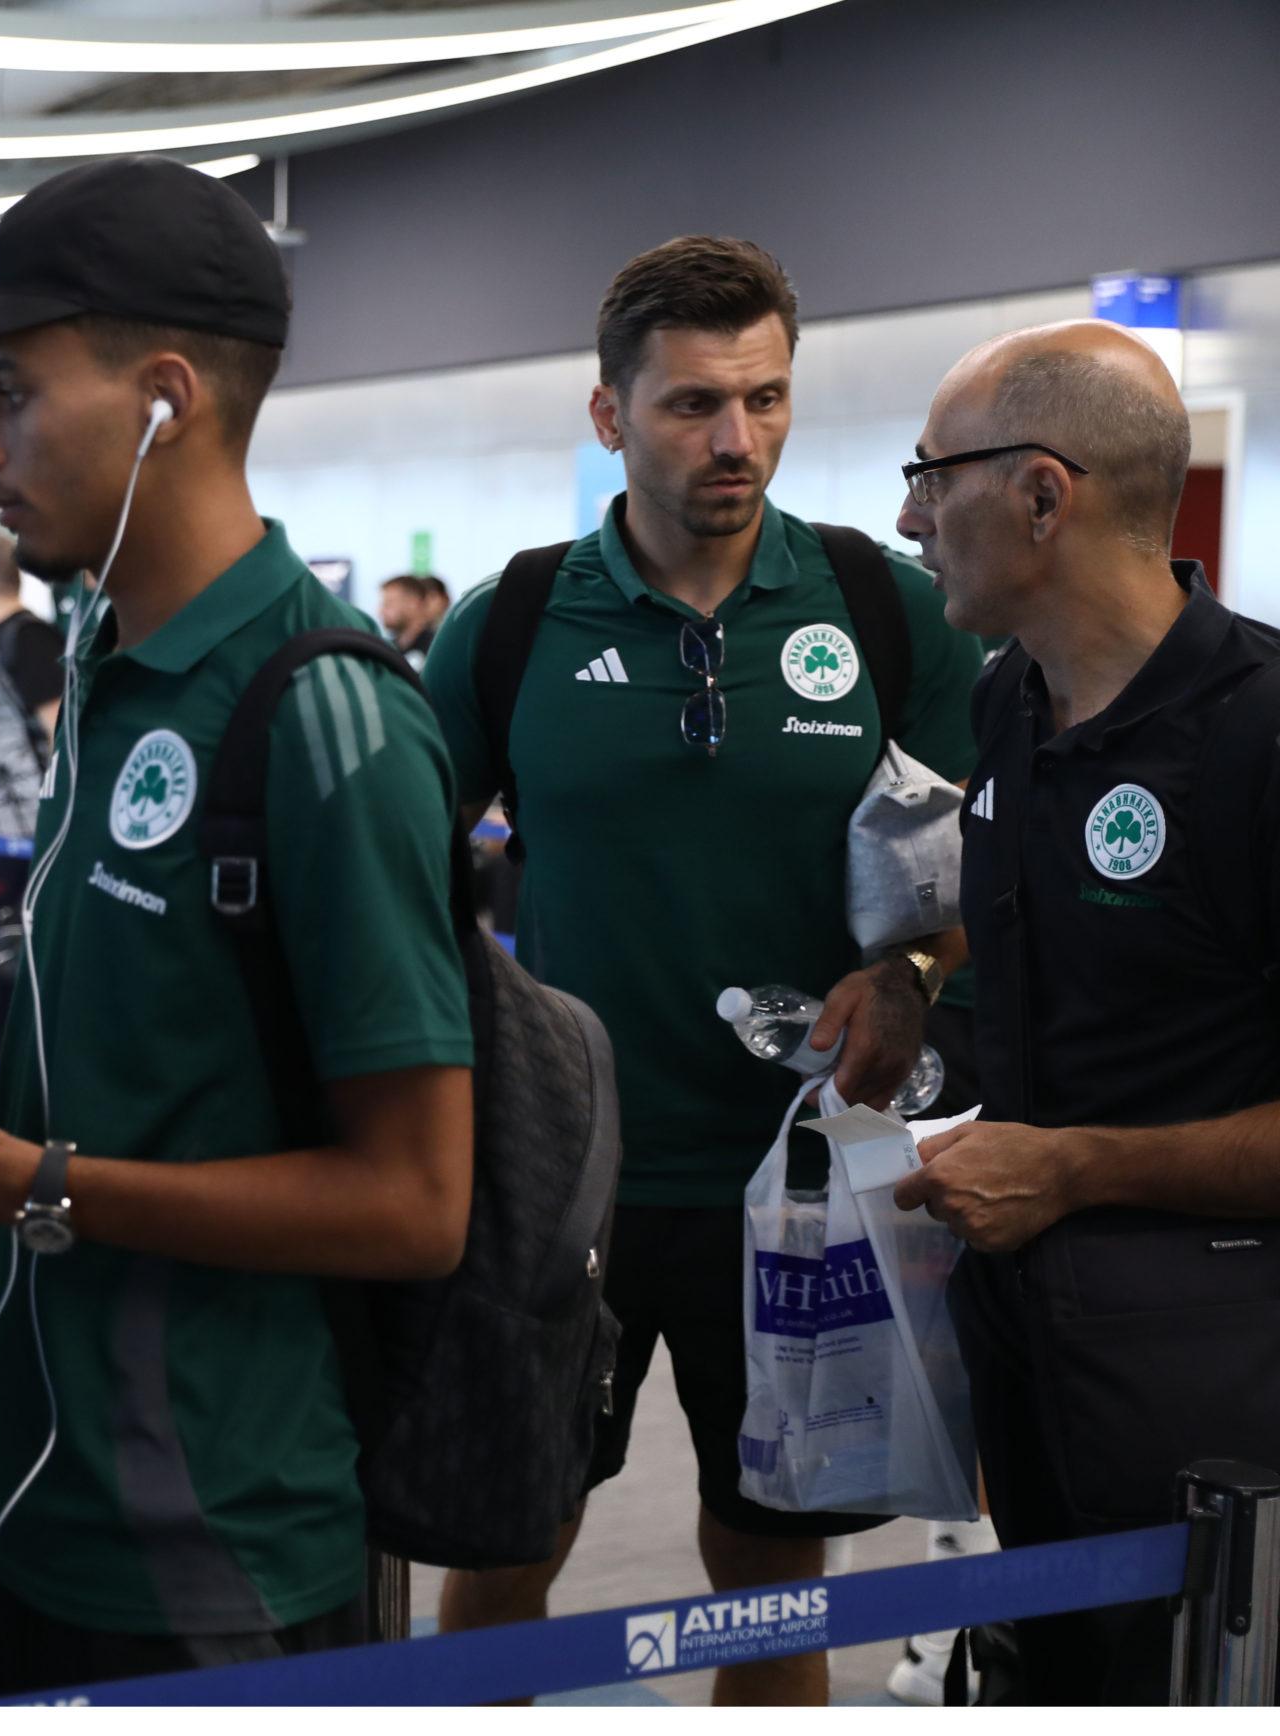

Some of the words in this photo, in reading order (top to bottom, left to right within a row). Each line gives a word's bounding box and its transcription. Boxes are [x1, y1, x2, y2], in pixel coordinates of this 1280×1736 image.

[782, 716, 863, 738] Stoiximan
[1108, 858, 1132, 872] 1908
[681, 1587, 829, 1636] ATHENS
[679, 1643, 760, 1666] ELEFTHERIOS
[763, 1631, 829, 1650] VENIZELOS
[680, 1626, 775, 1650] INTERNATIONAL
[778, 1616, 829, 1635] AIRPORT
